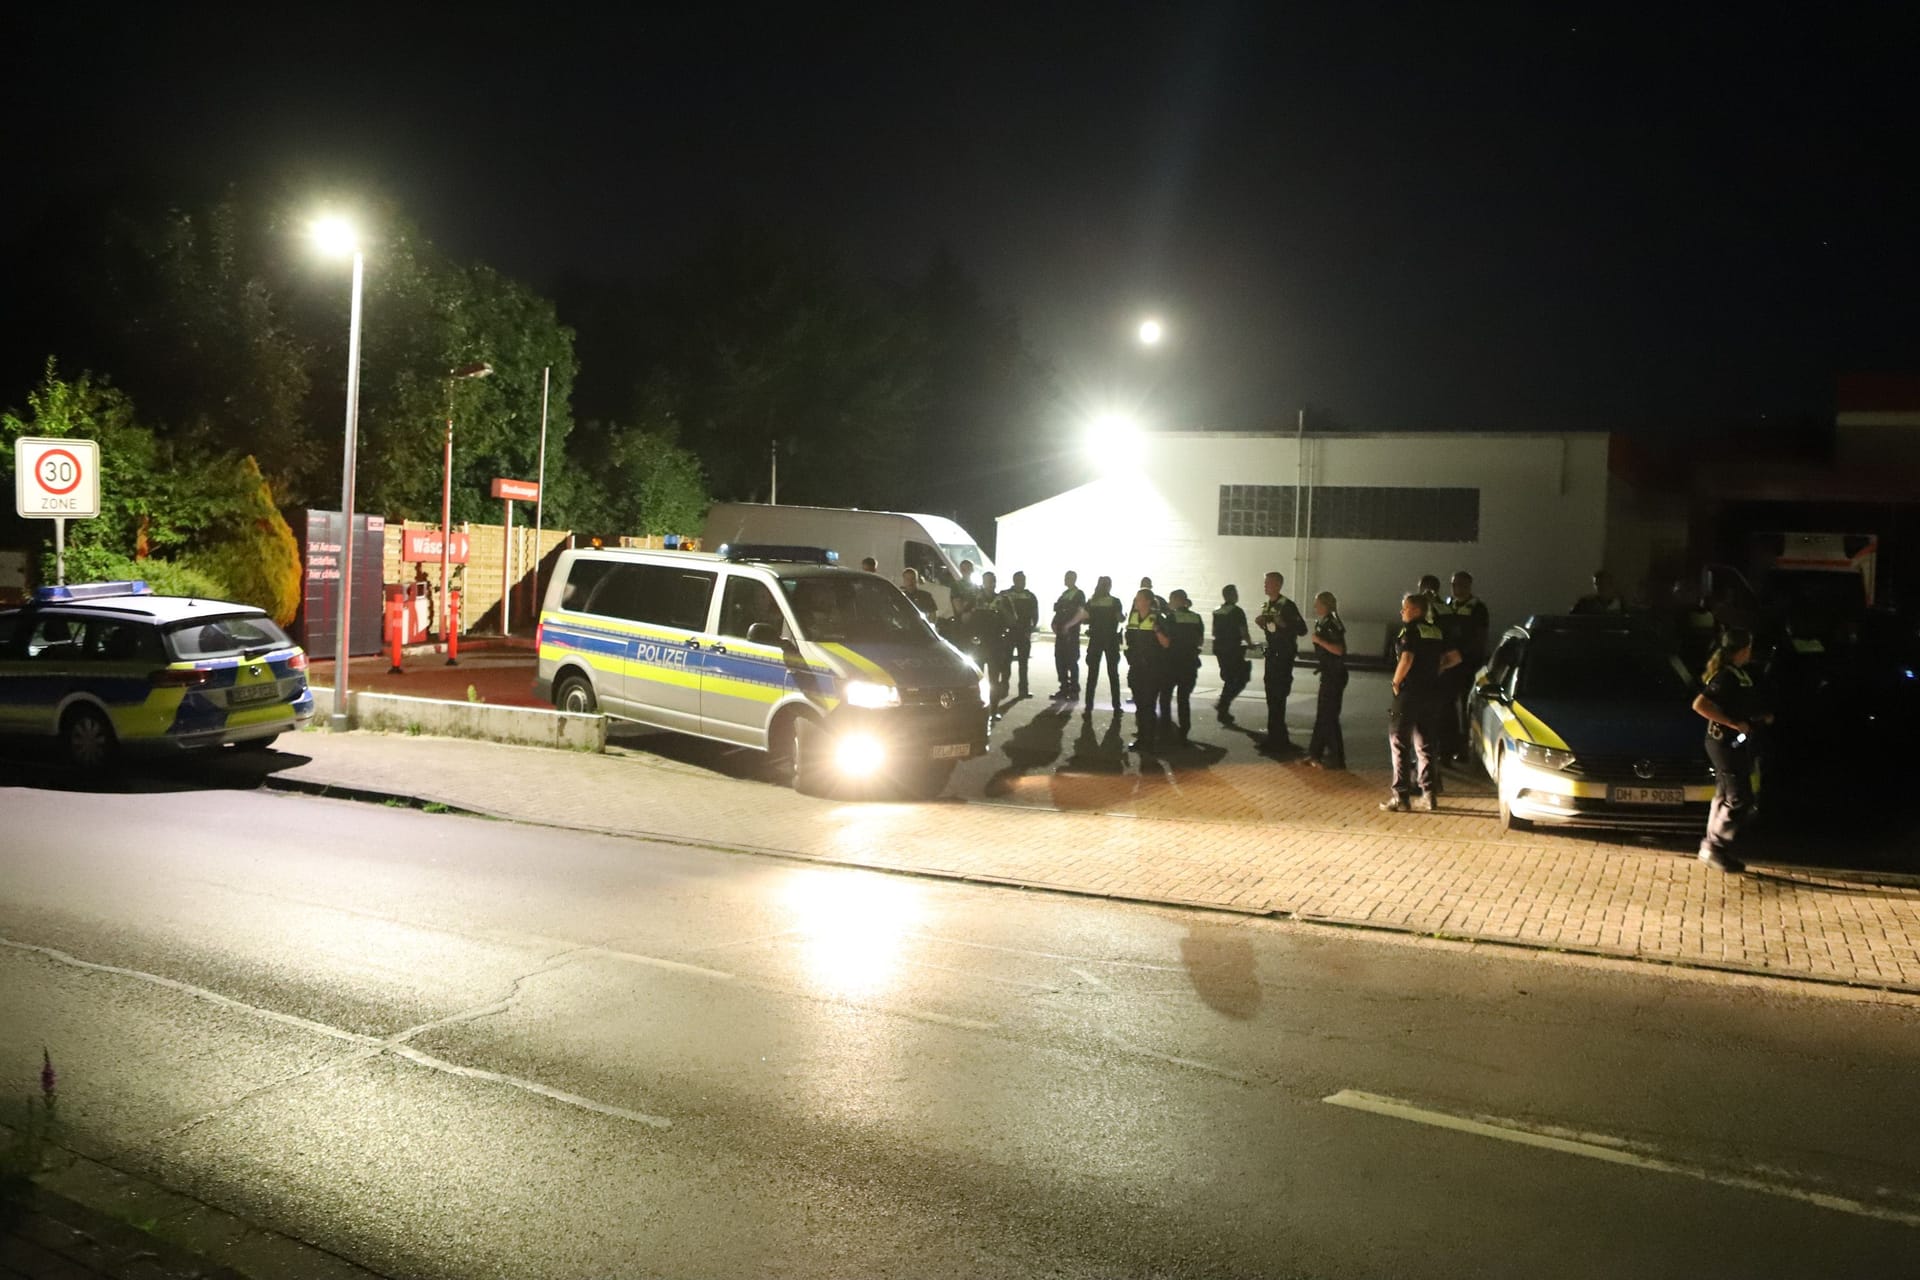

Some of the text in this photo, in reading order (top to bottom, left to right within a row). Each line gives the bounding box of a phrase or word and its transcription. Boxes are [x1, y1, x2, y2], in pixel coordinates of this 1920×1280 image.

[45, 461, 72, 482] 30
[41, 497, 78, 510] ZONE
[412, 537, 457, 555] Wäsce
[637, 643, 688, 668] POLIZEI
[1616, 789, 1632, 801] DH
[1640, 790, 1648, 801] P
